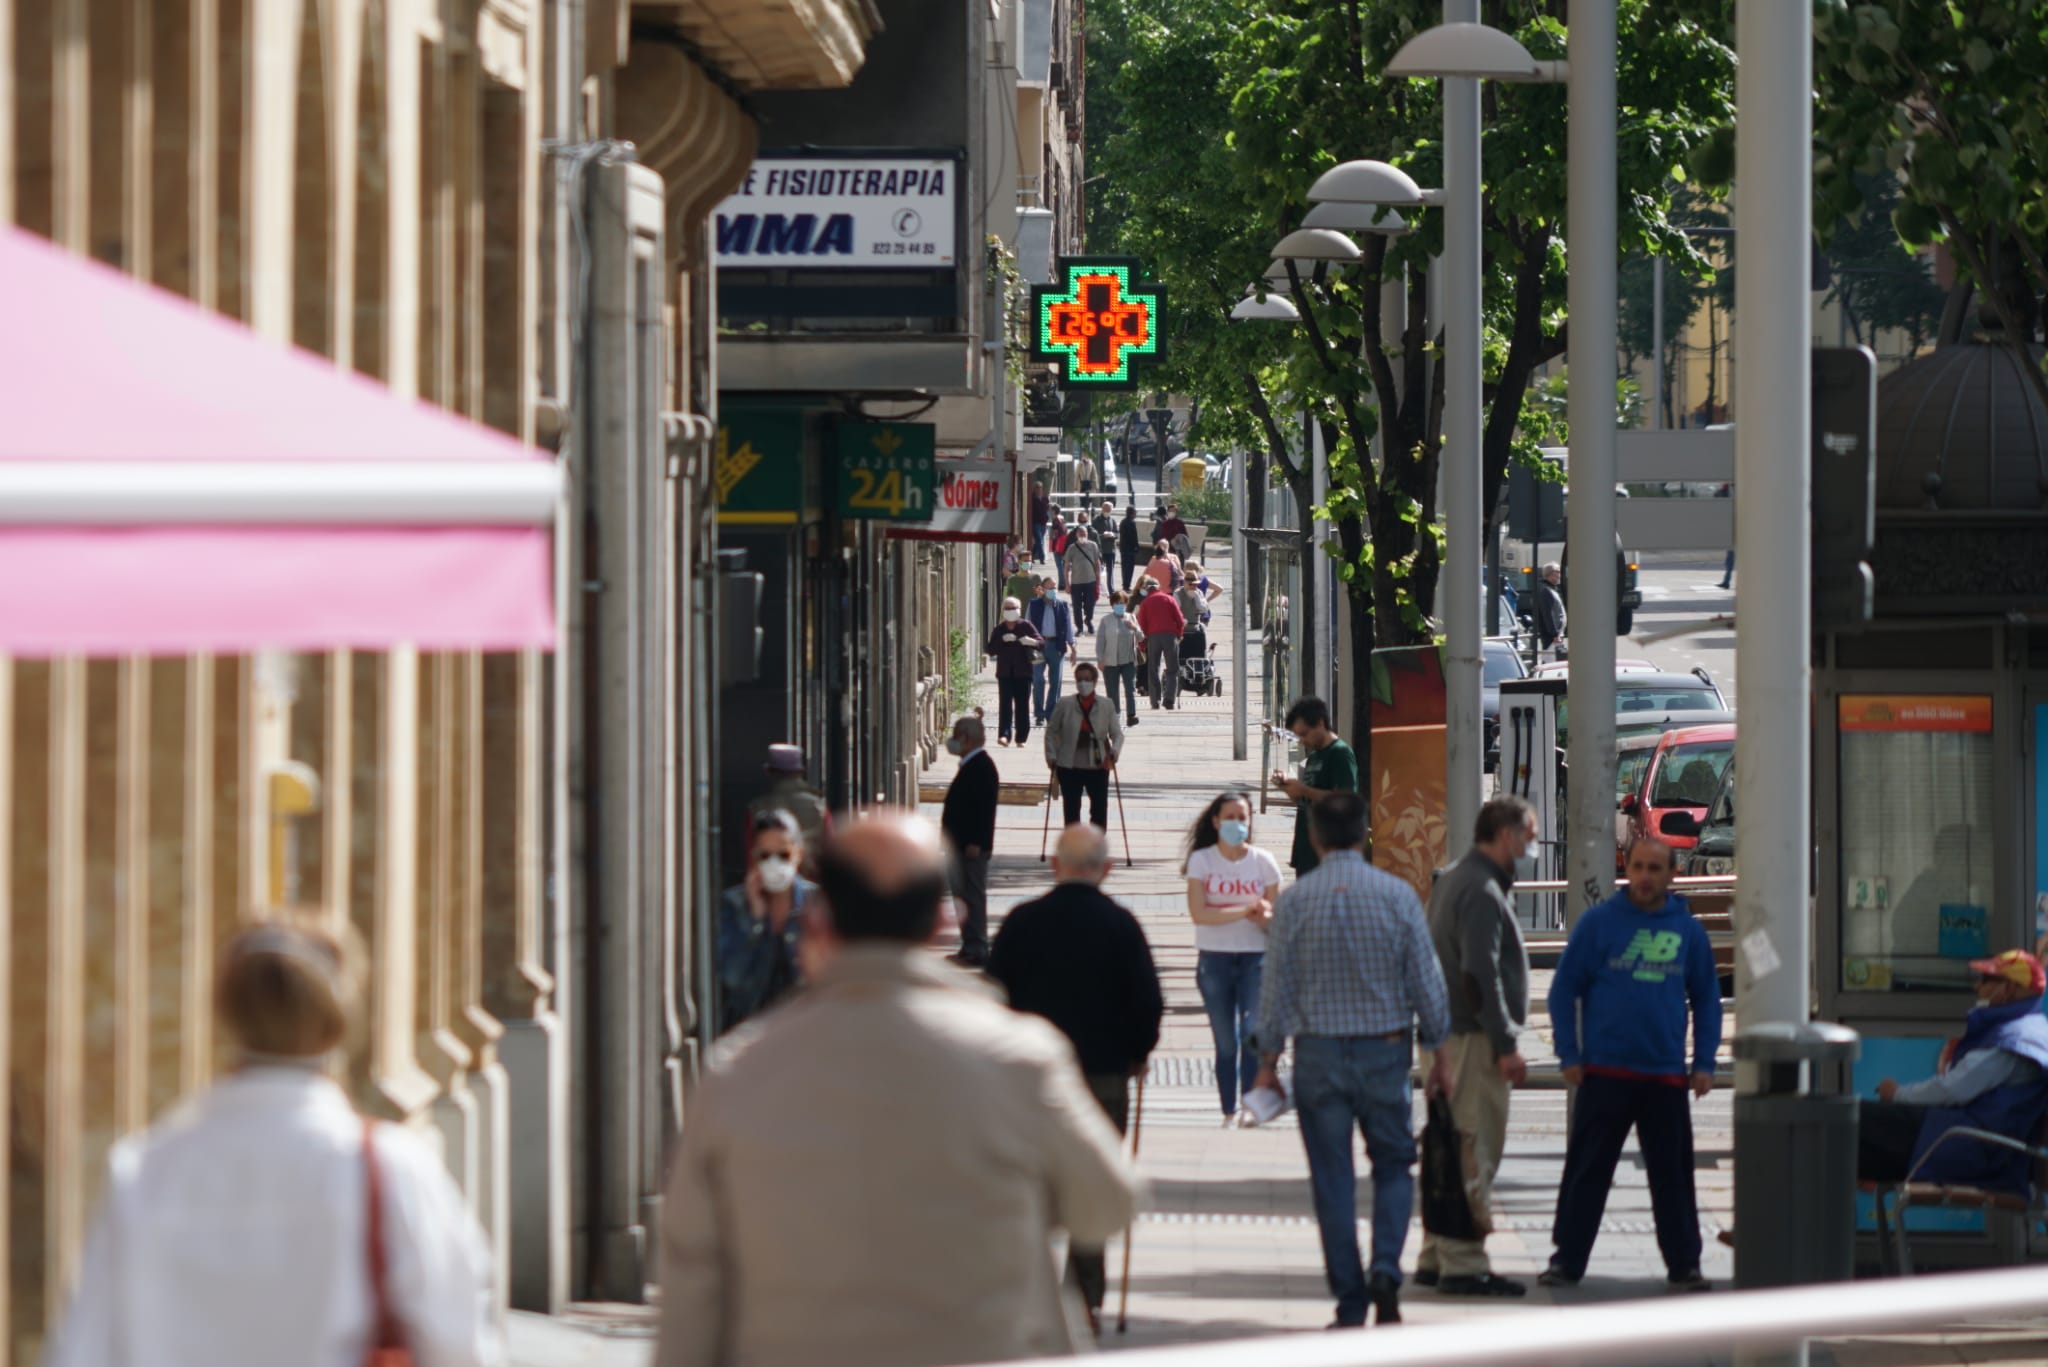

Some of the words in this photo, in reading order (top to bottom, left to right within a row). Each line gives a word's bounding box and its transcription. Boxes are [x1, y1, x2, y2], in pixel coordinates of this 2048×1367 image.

[734, 169, 758, 196] E
[766, 169, 944, 196] FISIOTERAPIA
[843, 456, 929, 470] CAJERO
[944, 472, 999, 510] Gómez
[1621, 929, 1682, 962] NB
